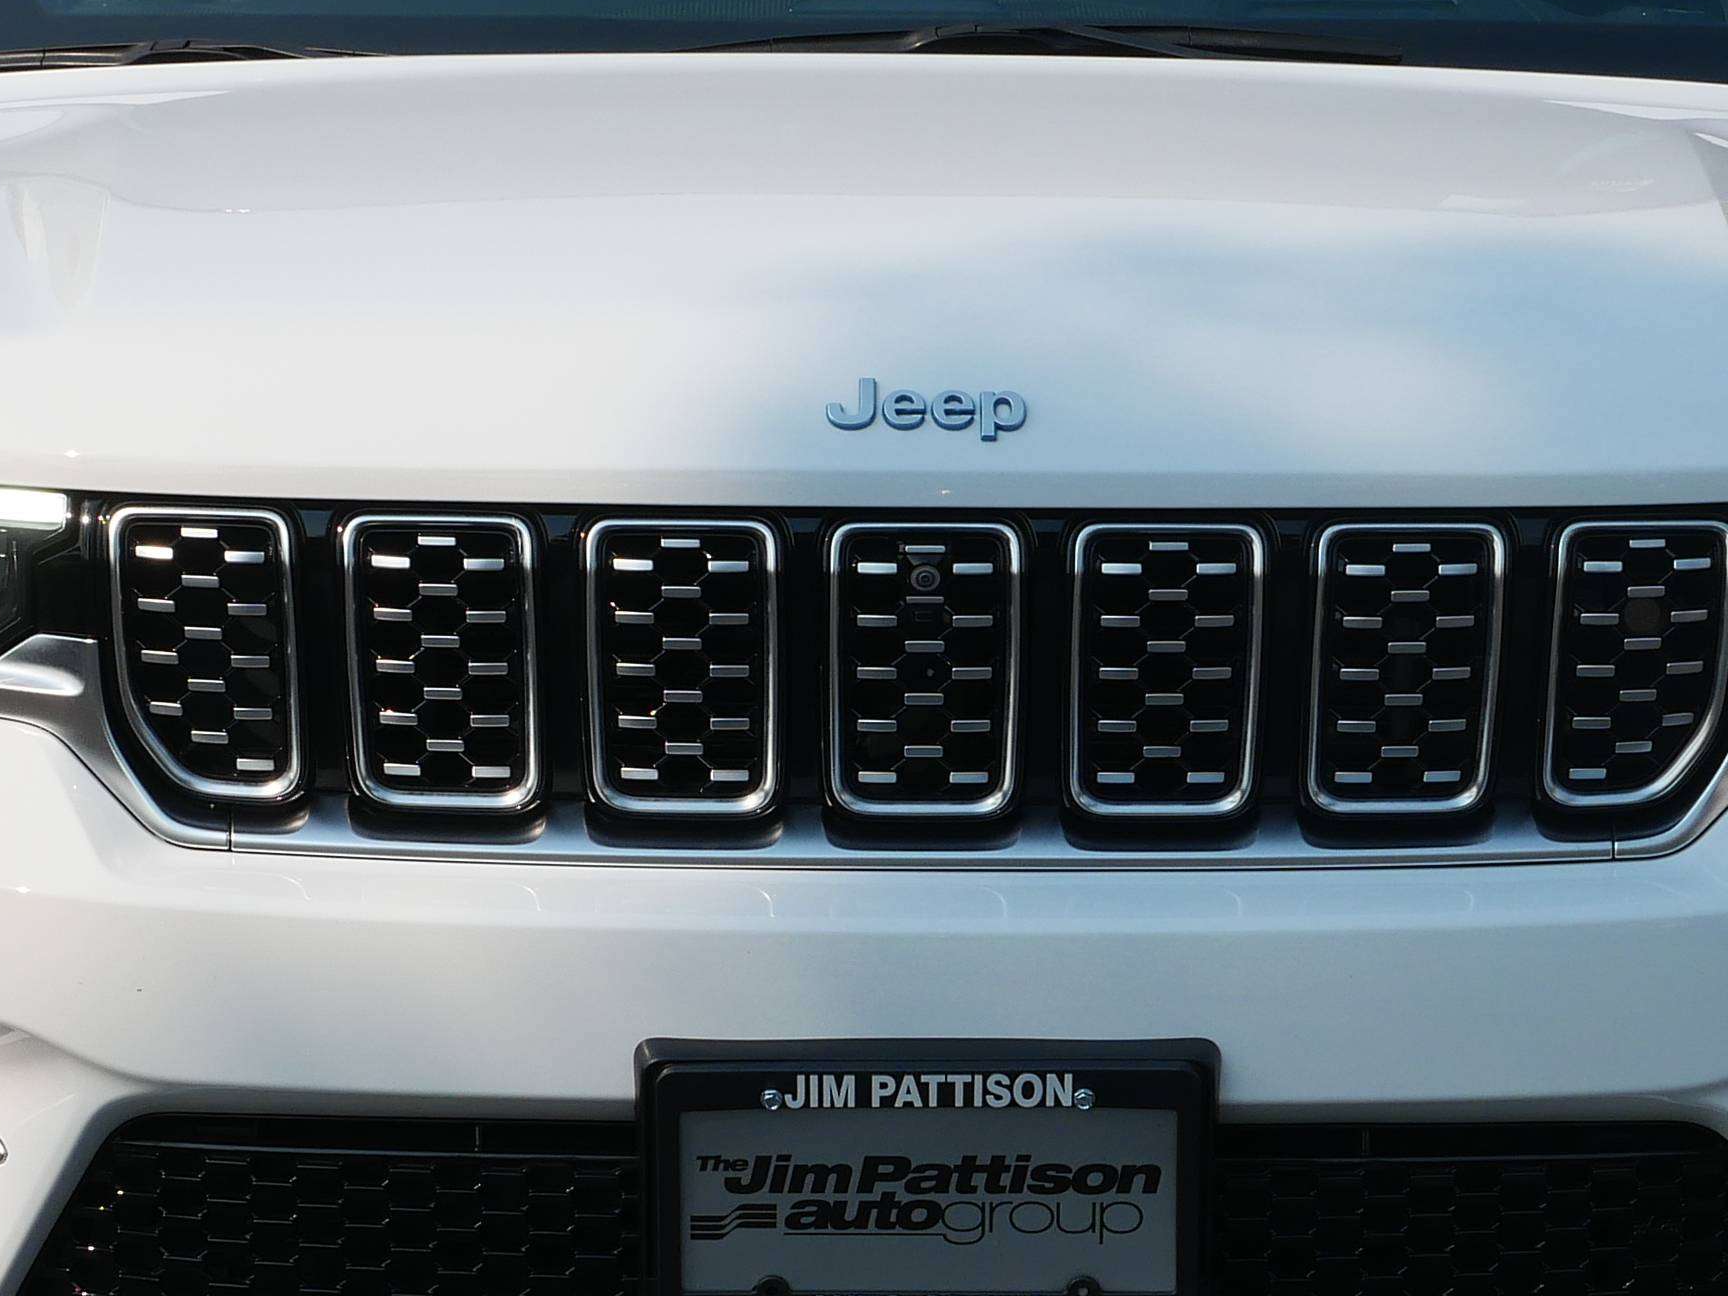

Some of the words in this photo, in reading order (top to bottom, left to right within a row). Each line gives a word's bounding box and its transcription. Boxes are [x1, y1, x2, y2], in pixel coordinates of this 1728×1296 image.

[826, 377, 1027, 442] Jeep
[784, 1073, 856, 1109] JIM
[872, 1073, 1073, 1108] PATTISON
[696, 1155, 749, 1172] The
